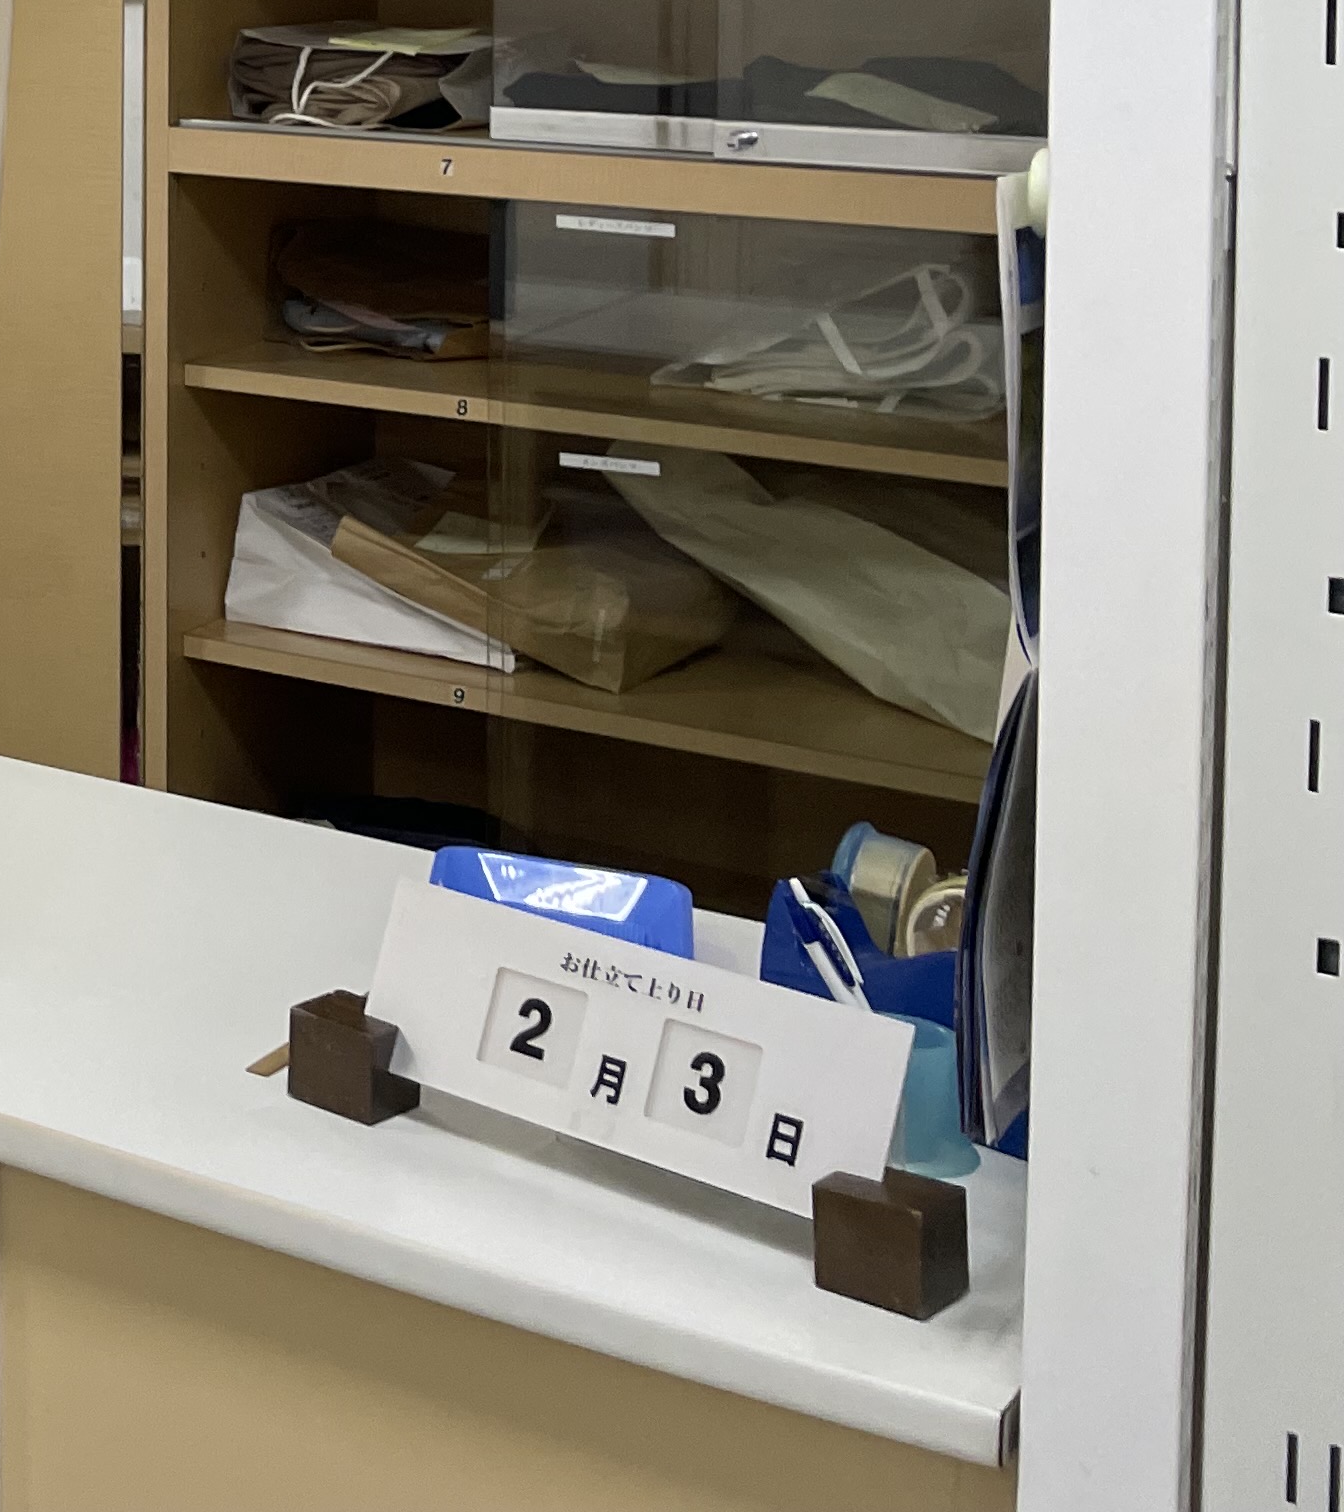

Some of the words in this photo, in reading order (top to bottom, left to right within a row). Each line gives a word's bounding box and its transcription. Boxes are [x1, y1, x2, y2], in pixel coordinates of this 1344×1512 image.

[441, 158, 453, 176] 7
[456, 399, 468, 416] 8
[453, 687, 466, 704] 9
[559, 952, 705, 1013] お仕立て上り日
